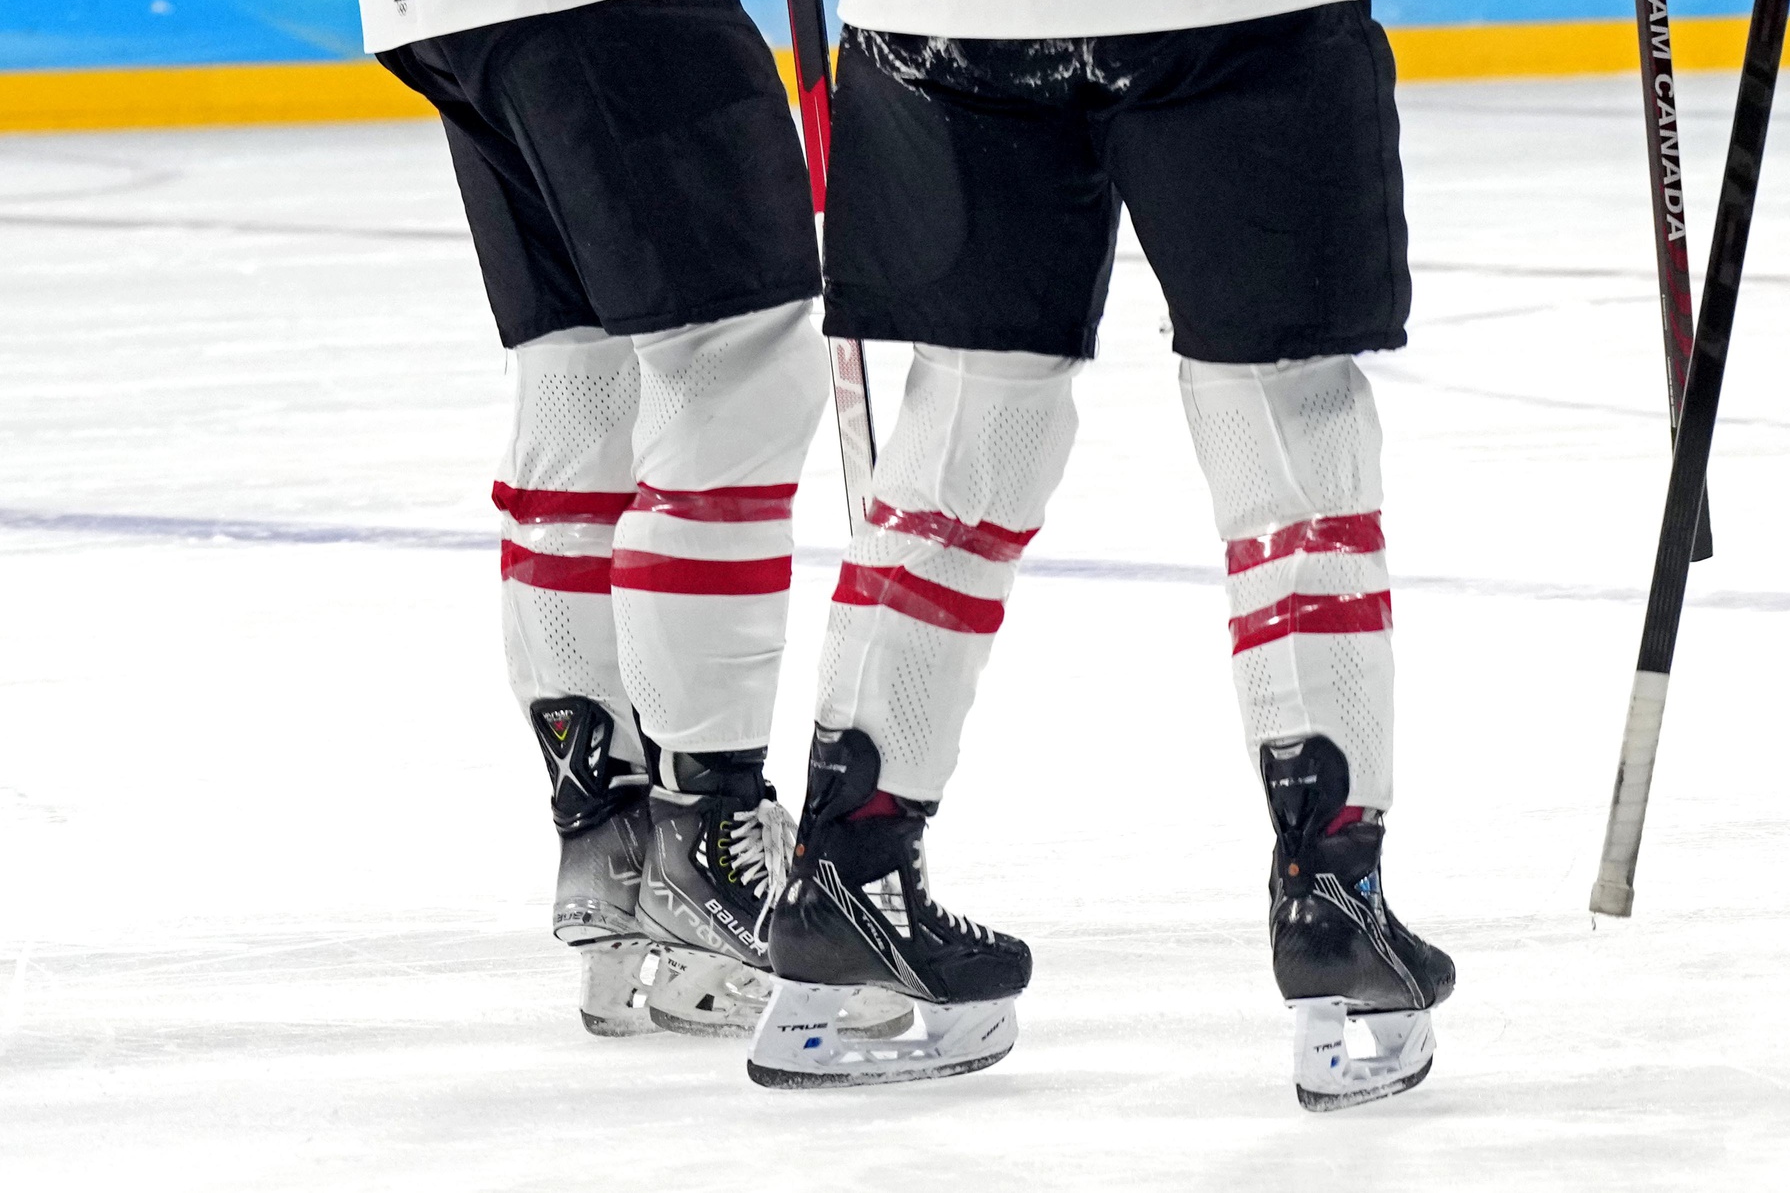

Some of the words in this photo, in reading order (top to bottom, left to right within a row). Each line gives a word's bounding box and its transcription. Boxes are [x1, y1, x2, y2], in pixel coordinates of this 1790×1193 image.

[1654, 72, 1687, 242] CANADA
[667, 957, 687, 972] TUK
[777, 1022, 829, 1033] TRUE
